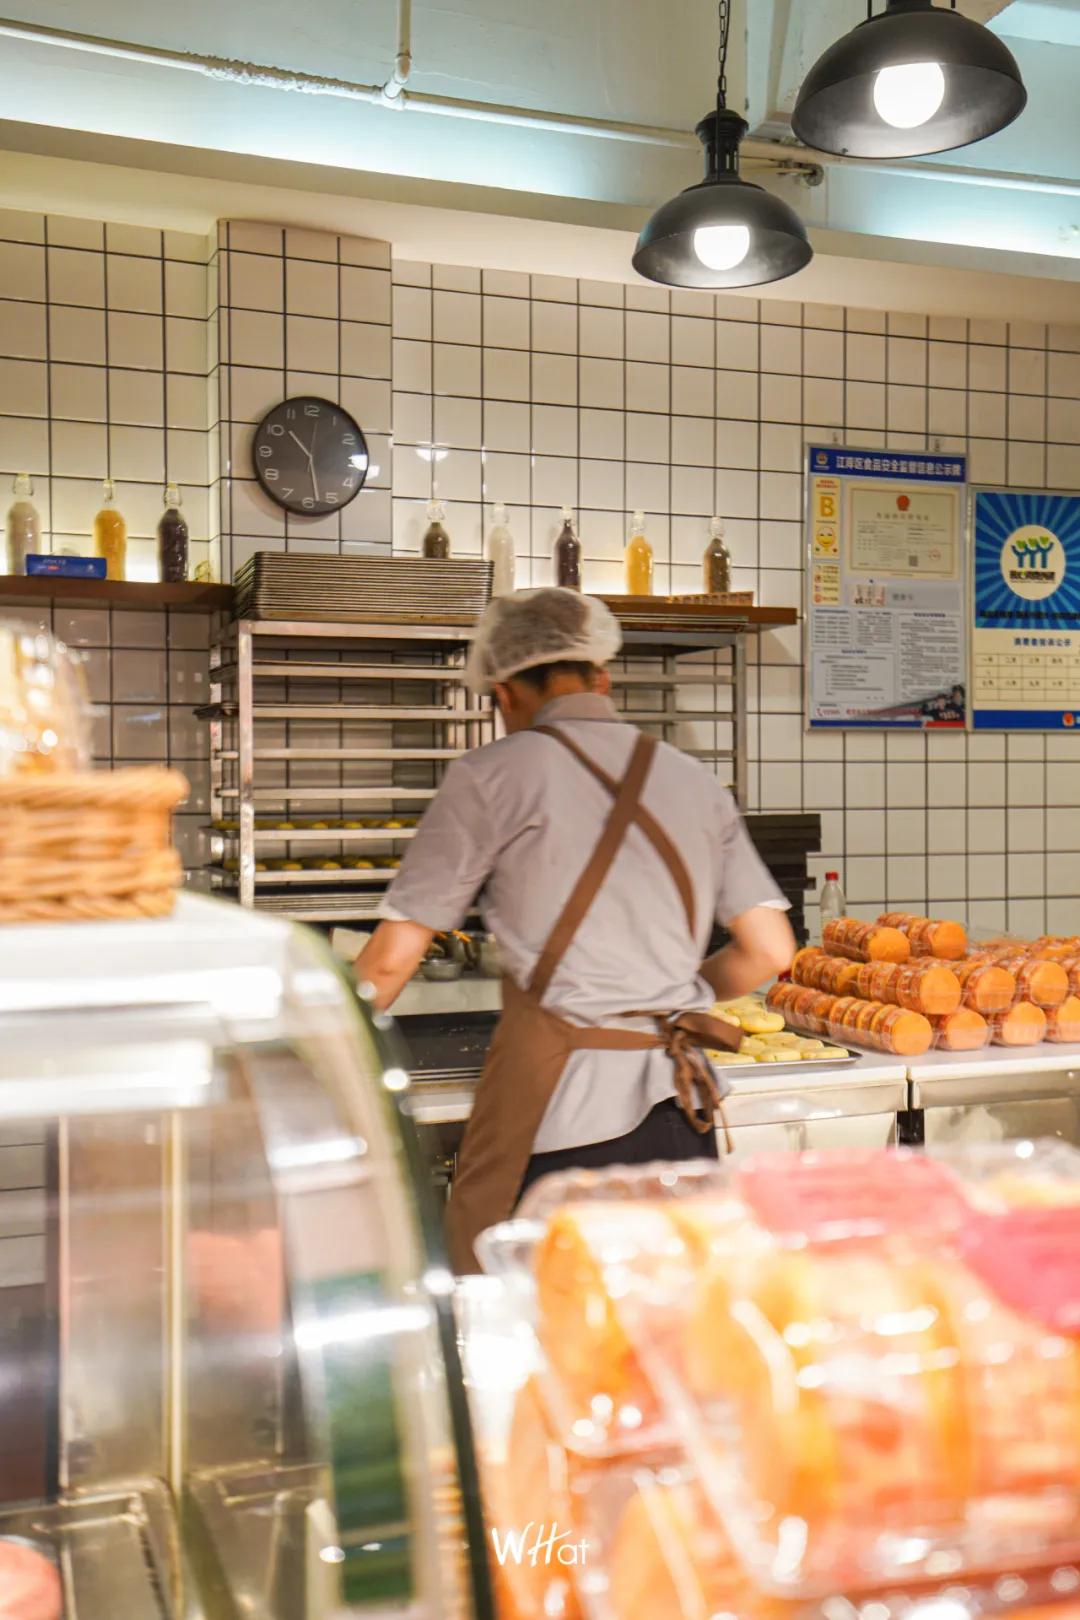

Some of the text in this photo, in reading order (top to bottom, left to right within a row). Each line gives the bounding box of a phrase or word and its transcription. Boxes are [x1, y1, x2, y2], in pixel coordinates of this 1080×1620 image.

[287, 408, 296, 420] 11
[304, 405, 320, 417] 12
[266, 424, 285, 436] 10
[343, 433, 355, 446] 2
[259, 446, 272, 458] 9
[265, 469, 279, 480] 8
[343, 478, 354, 488] 4
[282, 487, 294, 499] 7
[326, 493, 338, 504] 5
[303, 498, 315, 509] 6
[821, 496, 834, 516] B
